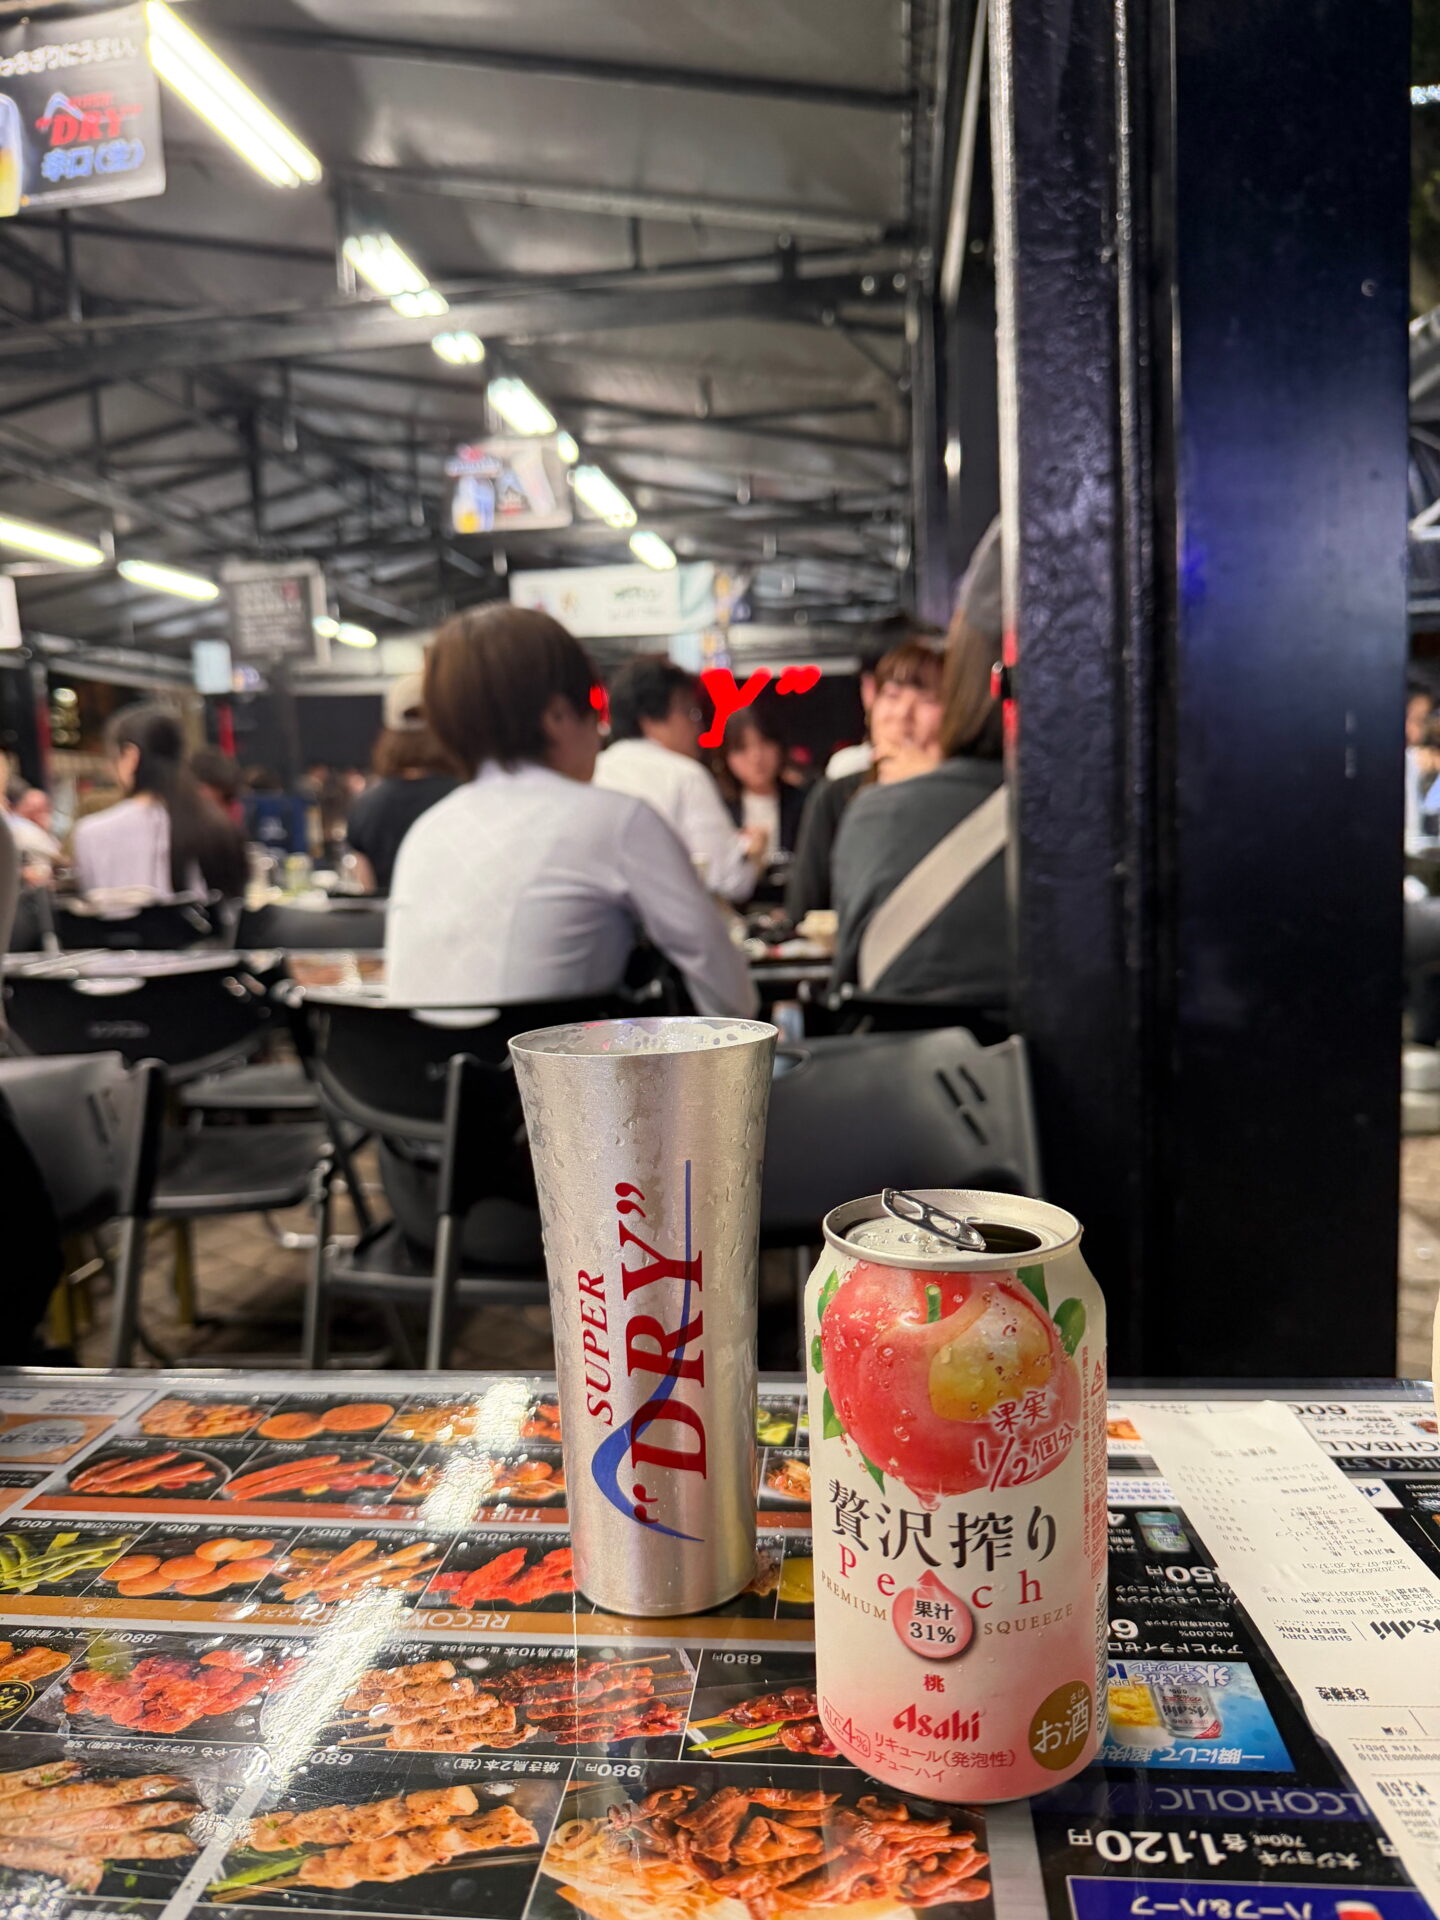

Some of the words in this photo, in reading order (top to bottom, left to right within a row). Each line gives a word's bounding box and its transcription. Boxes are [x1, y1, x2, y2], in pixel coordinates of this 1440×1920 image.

[578, 1269, 613, 1427] SUPER
[992, 1390, 1049, 1434] 果実
[1319, 1440, 1440, 1453] GHBALL
[829, 1478, 1057, 1572] 贅沢搾り
[821, 1570, 888, 1621] PREMIUM
[983, 1602, 1074, 1636] SQUEEZE
[914, 1599, 955, 1619] 果汁
[9, 1627, 91, 1641] コマイ唐揚げ
[909, 1622, 956, 1644] 31%
[1178, 1629, 1235, 1638] Alc.0.00%
[1274, 1624, 1306, 1634] PARK
[1280, 1632, 1308, 1641] DRY
[1309, 1626, 1347, 1635] BEER
[1309, 1633, 1353, 1642] SUPER
[1370, 1618, 1440, 1641] sahi
[1107, 1641, 1244, 1655] アサヒドライゼロ
[712, 1652, 763, 1666] 680円
[1130, 1661, 1196, 1673] キレッキレ
[923, 1673, 945, 1692] 桃
[1134, 1664, 1230, 1688] 氷を入れて
[1162, 1703, 1210, 1719] Asahi
[893, 1702, 981, 1743] Asahi
[1033, 1695, 1090, 1754] お酒
[452, 1757, 561, 1774] 焼き鳥2本(塩)
[585, 1763, 643, 1779] 980円
[874, 1750, 946, 1783] チューハイ
[1257, 1849, 1361, 1871] 大ジョッキ
[1130, 1895, 1313, 1920] ハーフ&ハーフ
